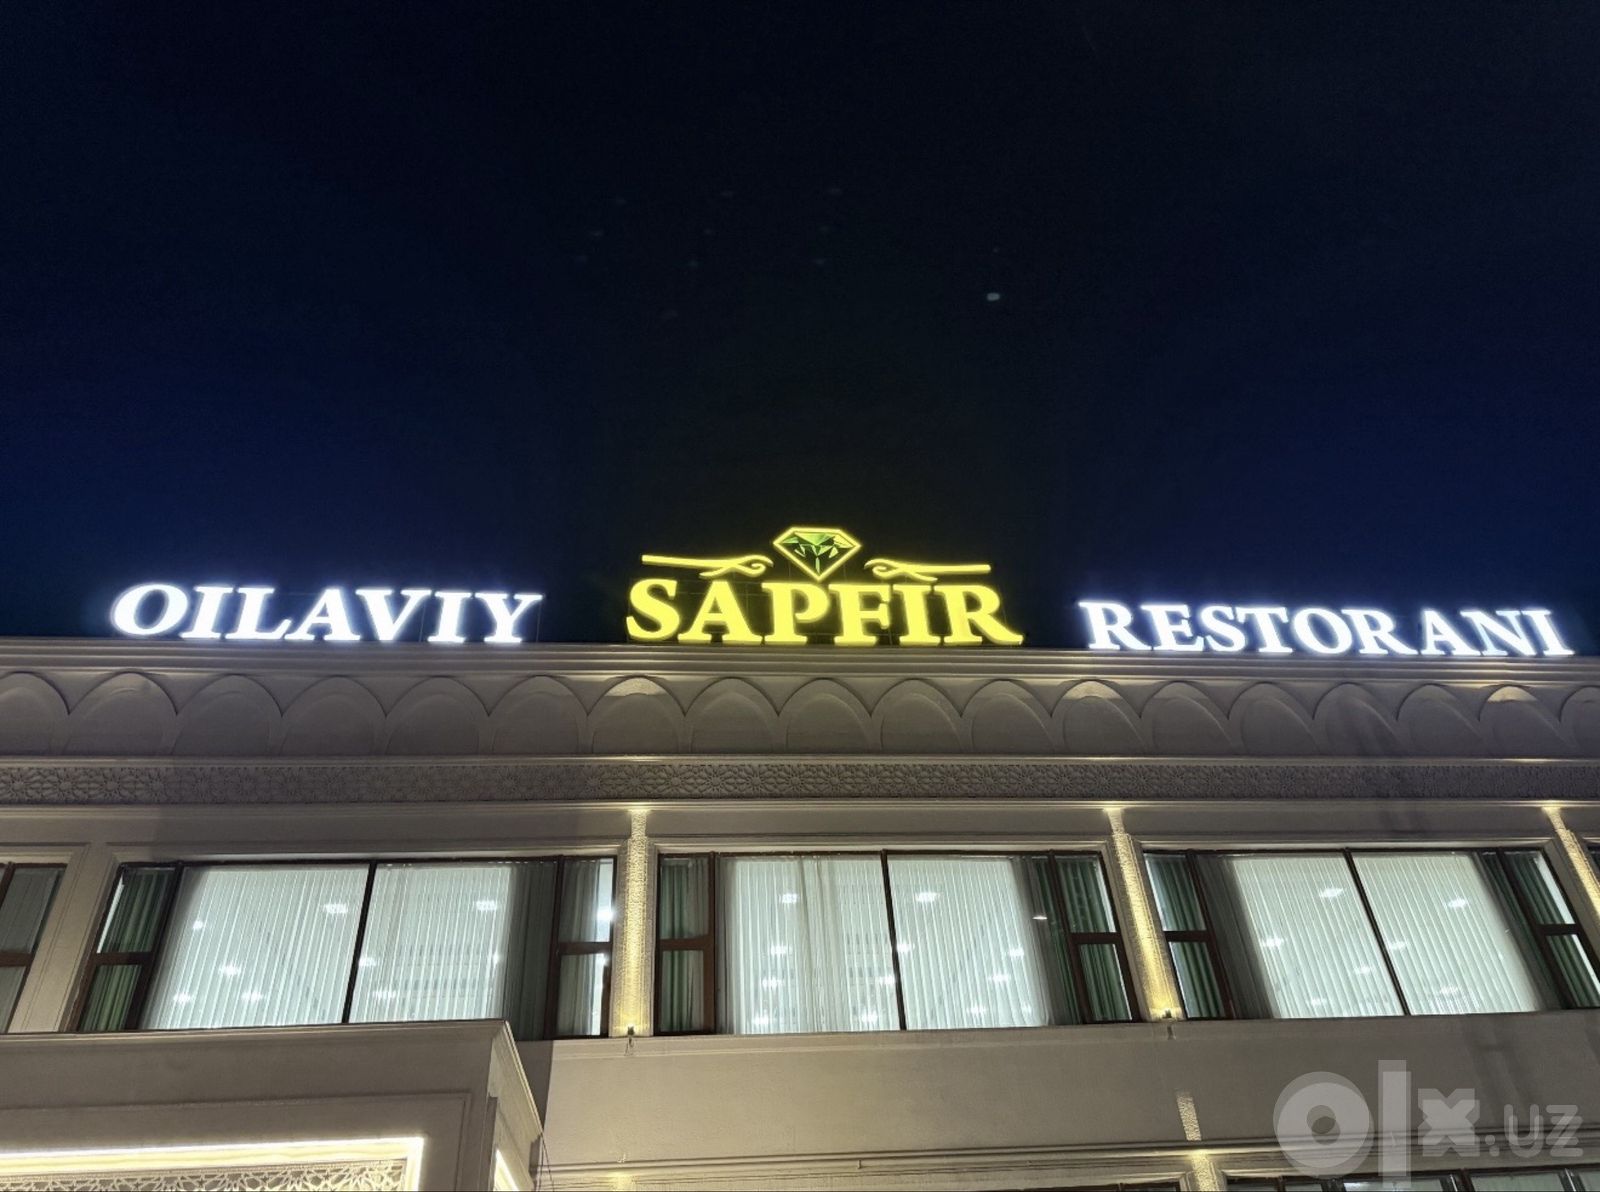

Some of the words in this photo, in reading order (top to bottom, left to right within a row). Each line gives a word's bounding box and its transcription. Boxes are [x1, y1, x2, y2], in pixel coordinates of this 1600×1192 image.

[111, 583, 542, 644] OILAVIY
[626, 577, 1024, 646] SAPFIR
[1078, 601, 1574, 657] RESTORANI
